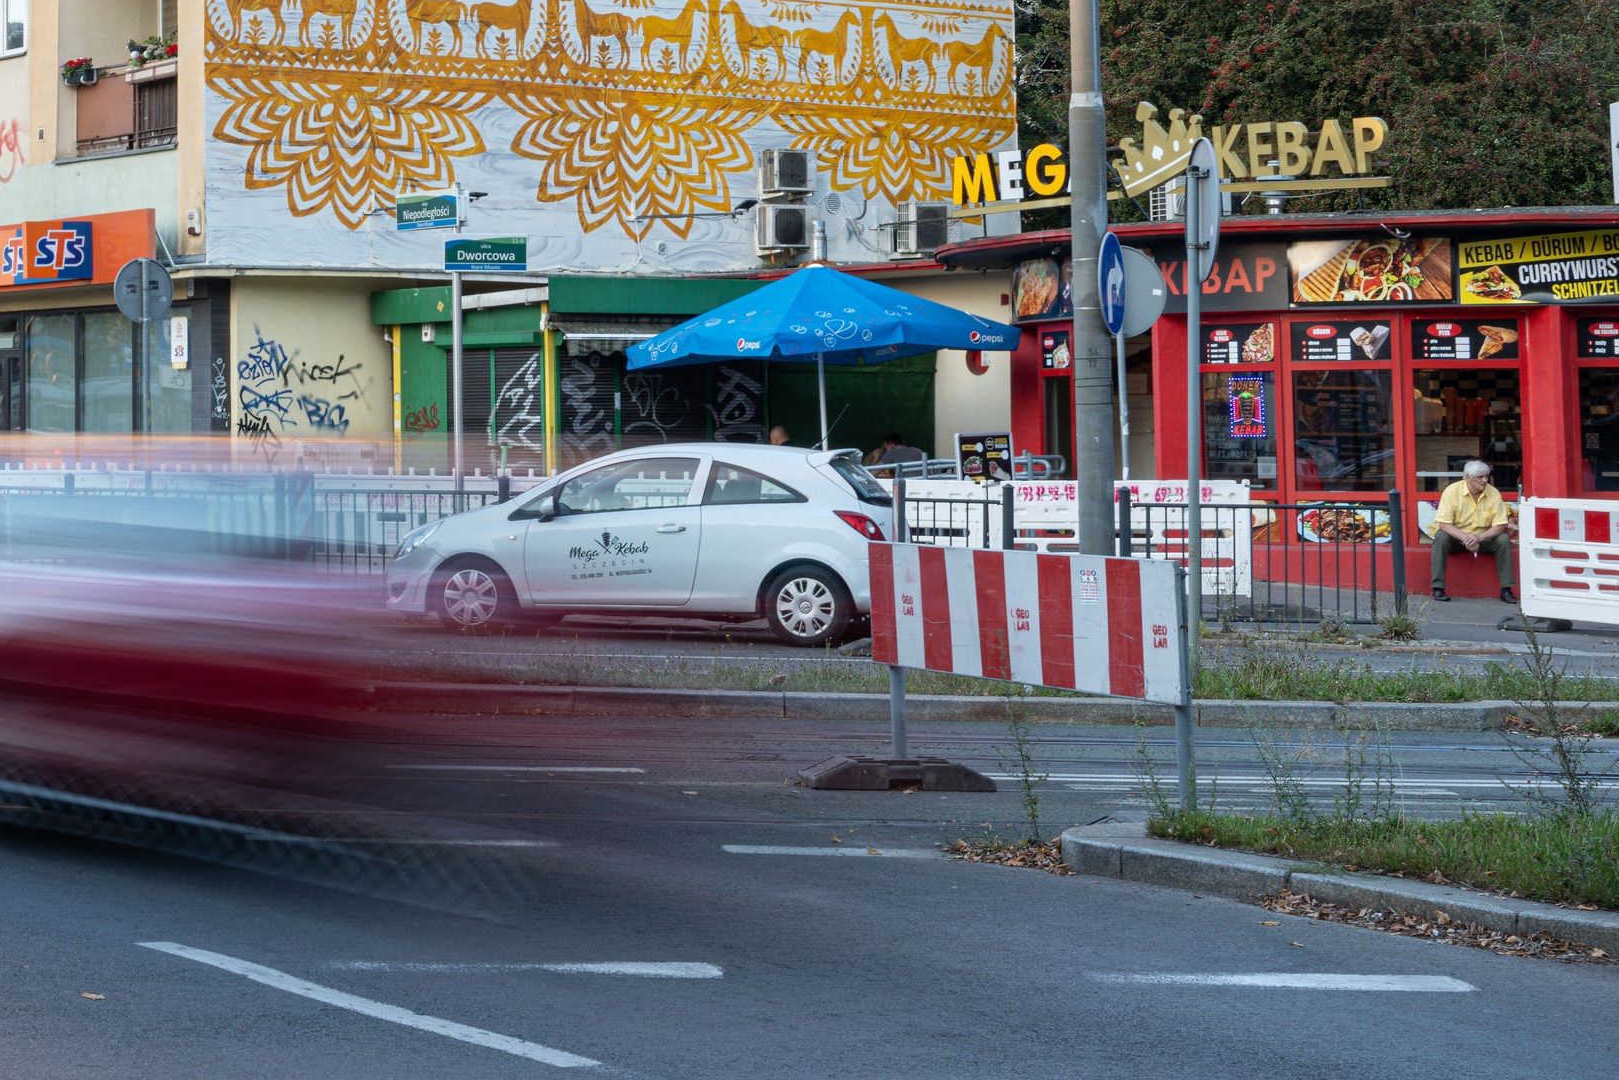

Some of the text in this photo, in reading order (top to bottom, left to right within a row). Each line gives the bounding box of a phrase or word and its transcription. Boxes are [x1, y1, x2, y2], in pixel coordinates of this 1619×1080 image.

[953, 117, 1389, 205] MEG KEBAP
[402, 206, 450, 221] Niepodległości
[34, 229, 86, 270] STS
[457, 250, 516, 261] Dworcowa
[1465, 243, 1514, 264] KEBAB
[1532, 237, 1585, 258] DÜRUM
[745, 340, 760, 350] pepsi
[981, 334, 1004, 344] pepsi
[1233, 425, 1263, 434] KEBAB
[569, 541, 649, 562] Mega Kebab
[572, 558, 645, 570] SZCZECIN
[1016, 607, 1029, 619] GEO
[1017, 621, 1030, 632] LAB
[1152, 624, 1167, 636] GEO
[1153, 637, 1167, 649] LAB
